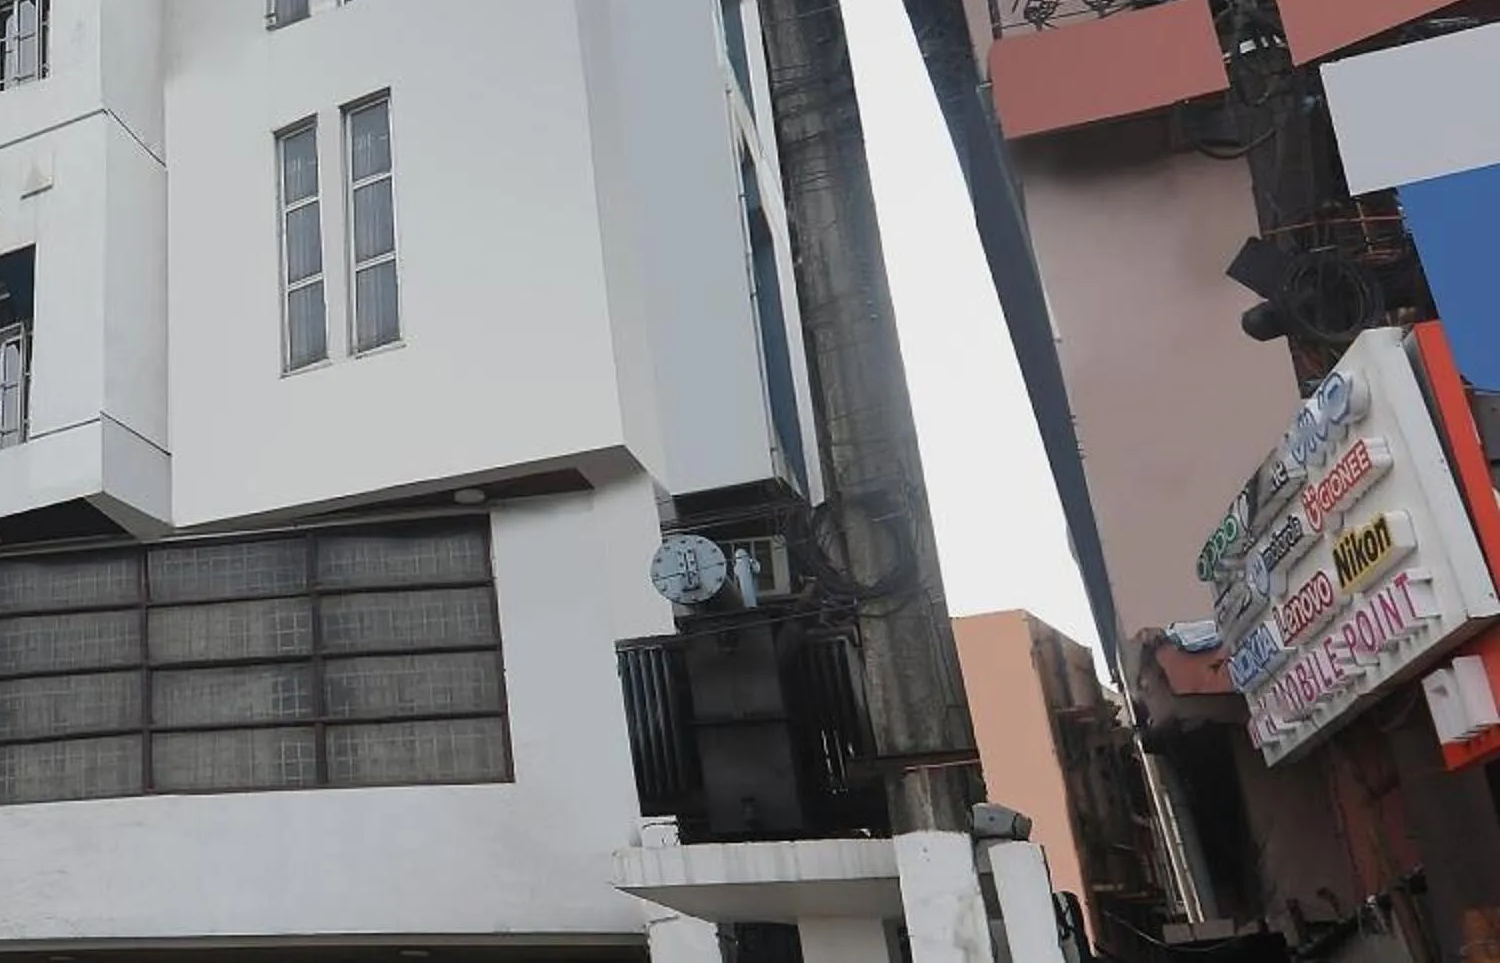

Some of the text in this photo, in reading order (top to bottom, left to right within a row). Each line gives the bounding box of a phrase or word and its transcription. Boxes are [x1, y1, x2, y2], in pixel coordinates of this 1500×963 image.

[1318, 439, 1372, 512] GIONEE
[1332, 516, 1391, 587] Nikon
[1272, 571, 1333, 646] Lenovo
[1342, 572, 1418, 667] POINT
